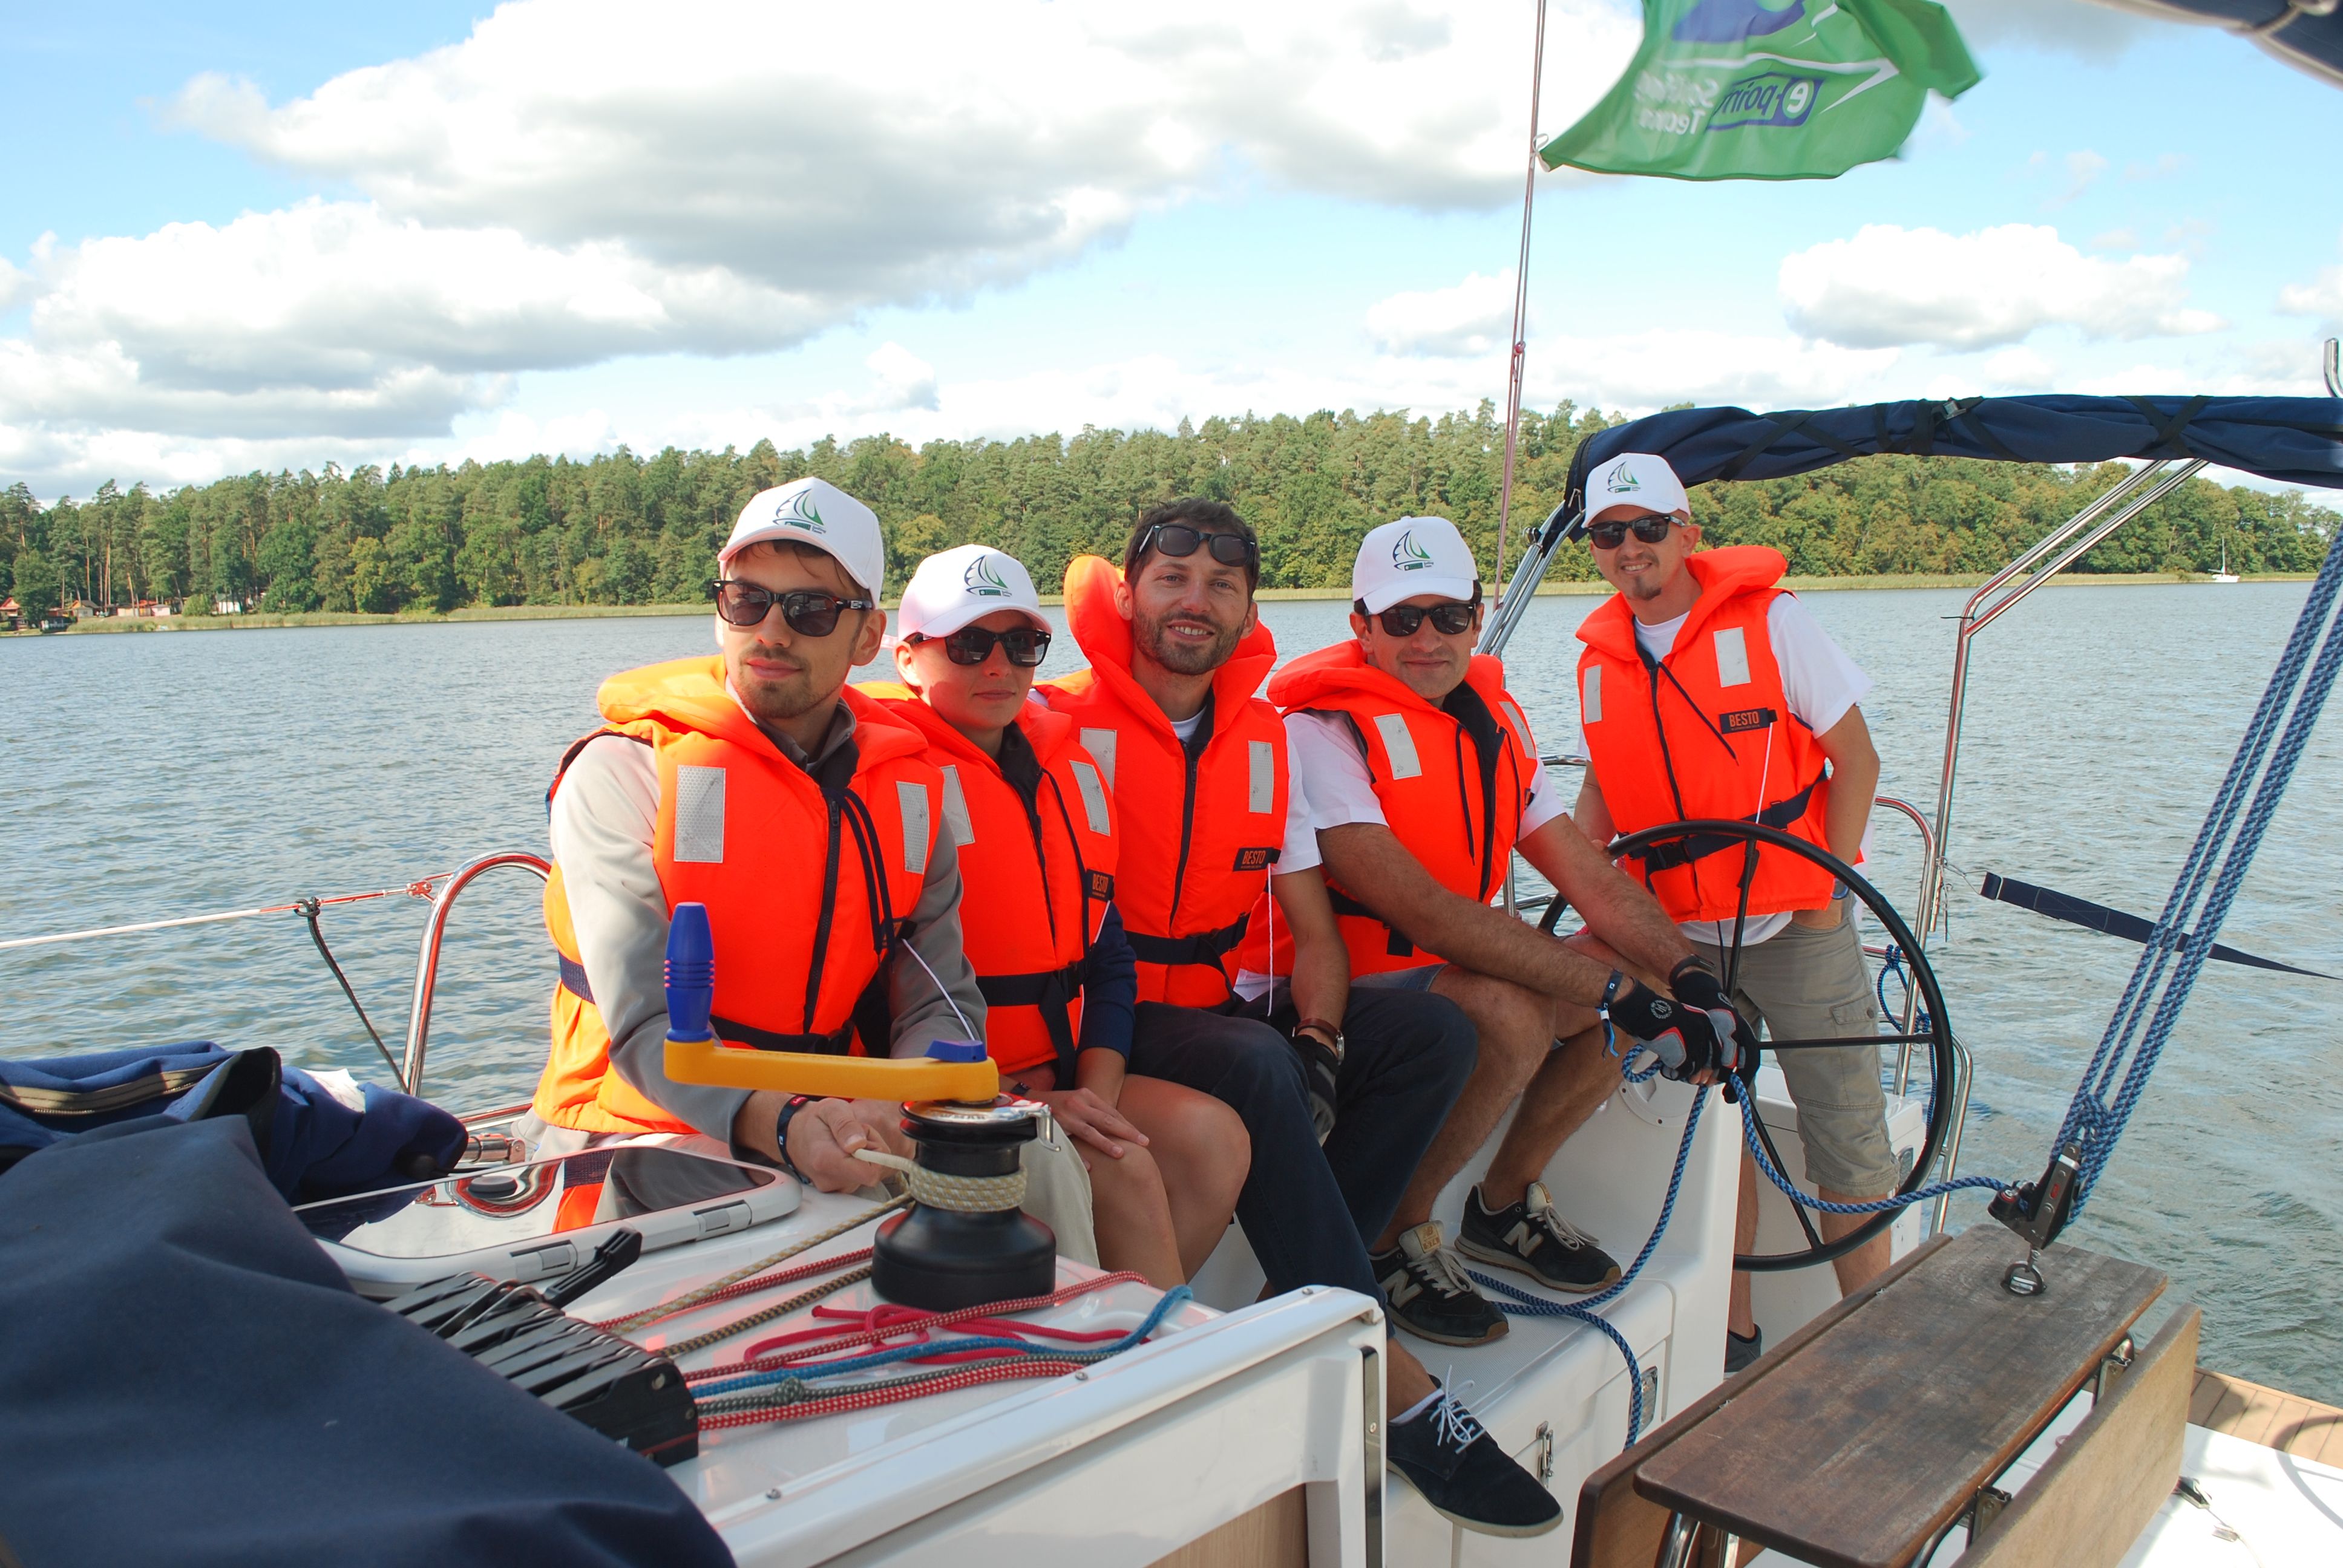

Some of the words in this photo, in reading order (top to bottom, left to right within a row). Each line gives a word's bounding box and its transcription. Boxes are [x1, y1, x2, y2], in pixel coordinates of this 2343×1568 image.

[1729, 711, 1760, 727] BESTO
[1242, 850, 1267, 864] BESTO
[1092, 874, 1109, 893] BESTO
